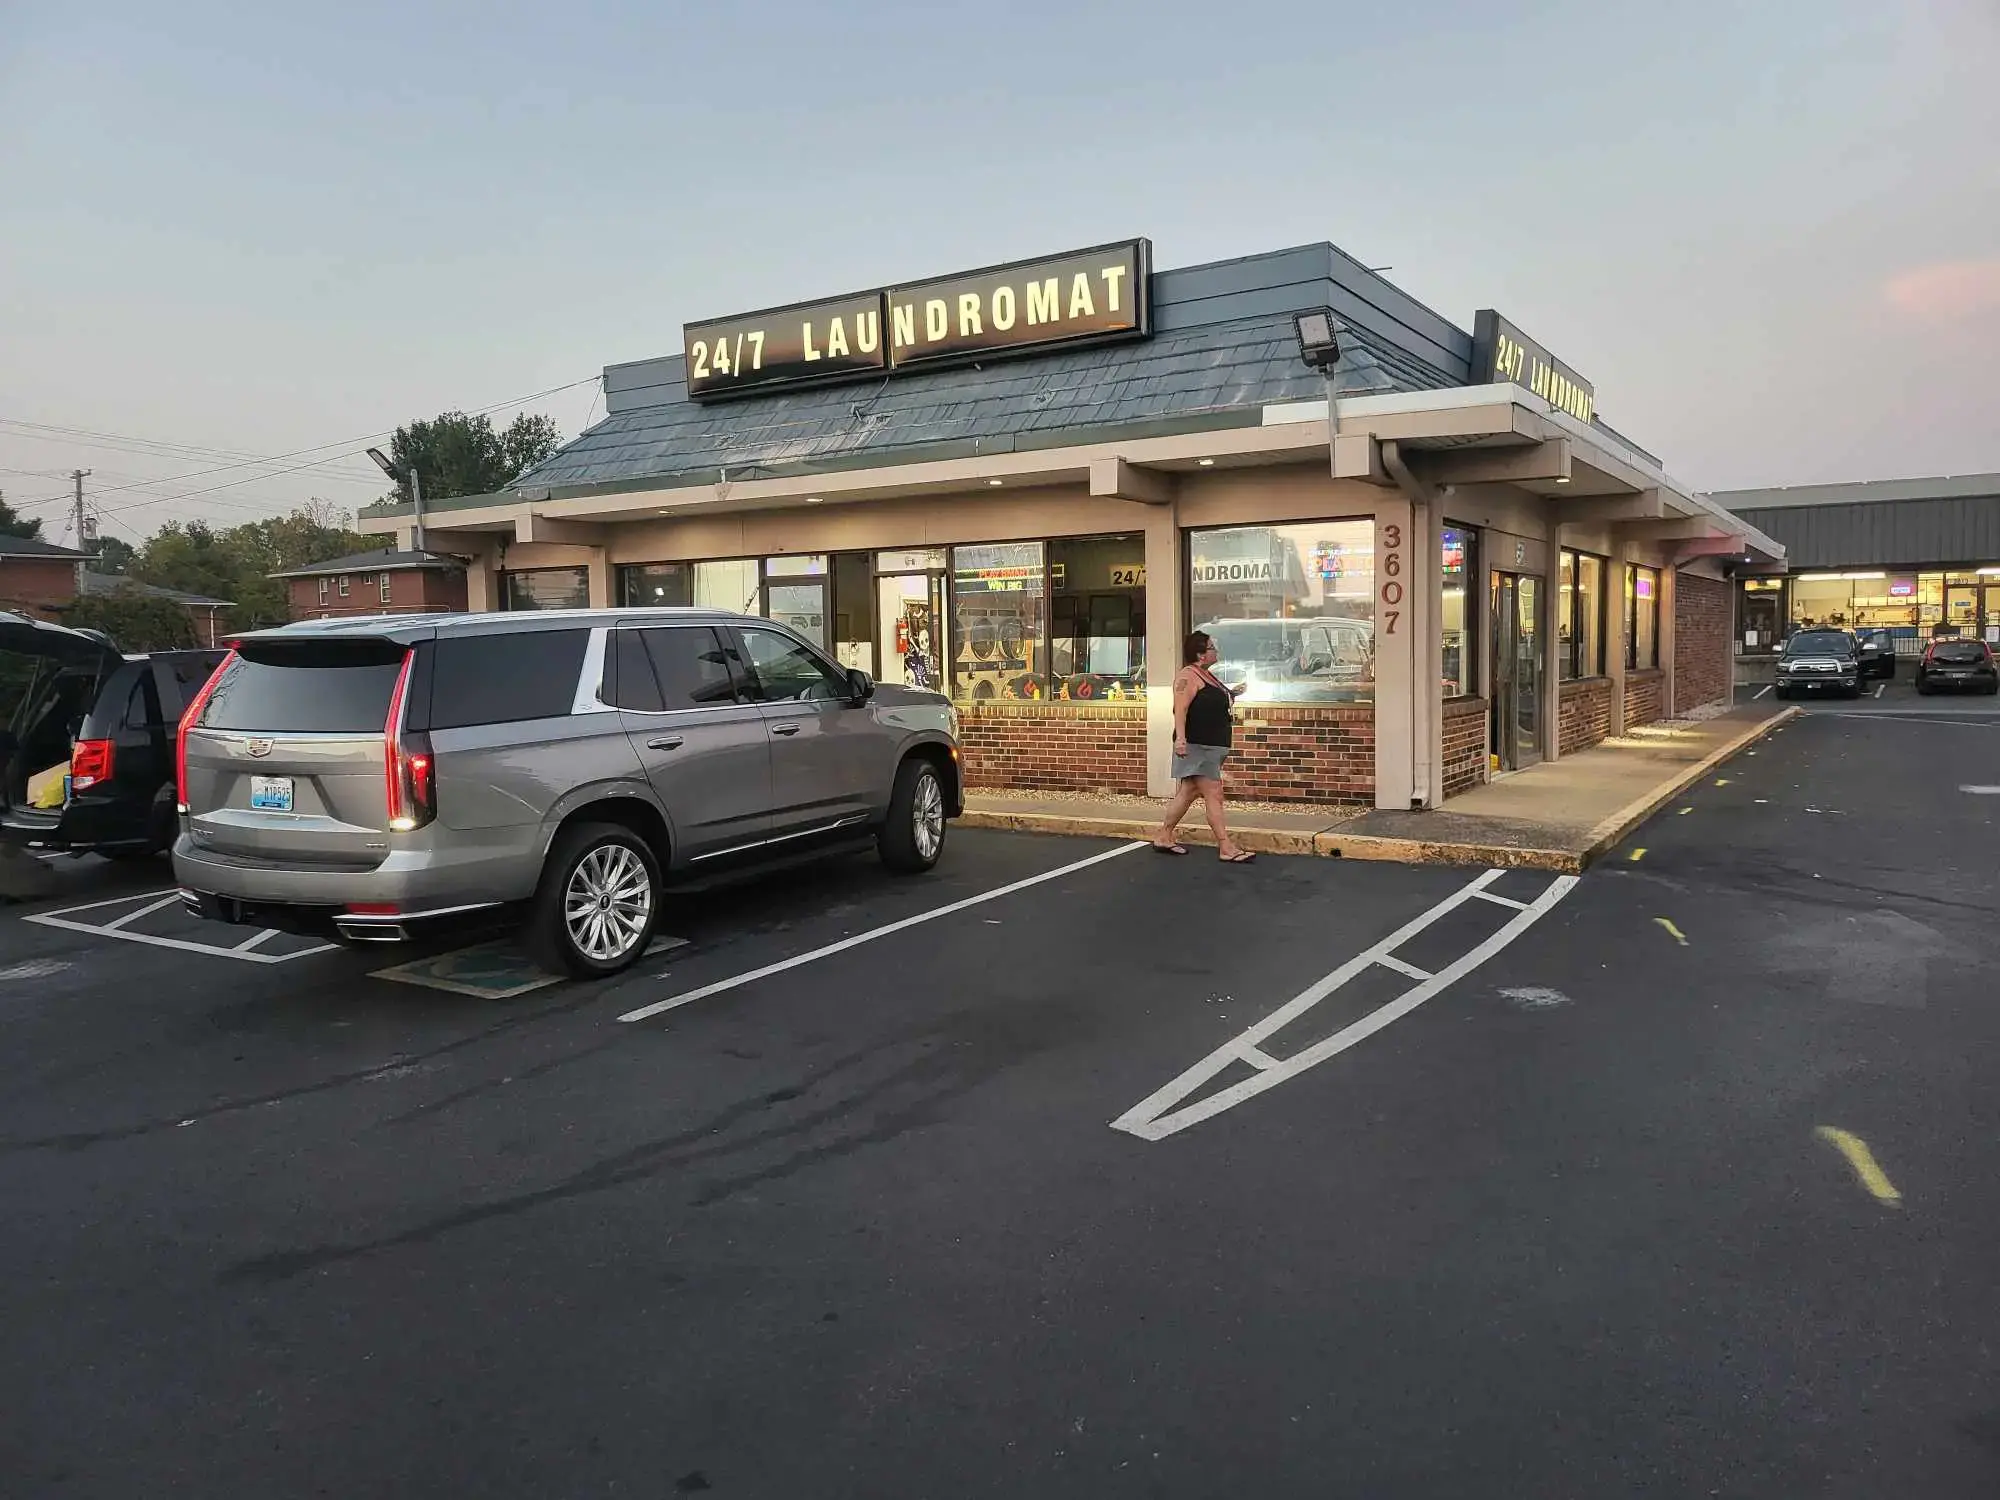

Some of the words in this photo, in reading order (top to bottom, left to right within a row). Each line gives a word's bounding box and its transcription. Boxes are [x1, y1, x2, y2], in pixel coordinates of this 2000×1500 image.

[691, 330, 766, 379] 24/7
[802, 264, 1126, 363] LAUNDROMAT
[1496, 334, 1525, 382] 24/7
[1530, 356, 1593, 425] LAUNDROMAT
[1381, 524, 1403, 635] 3607
